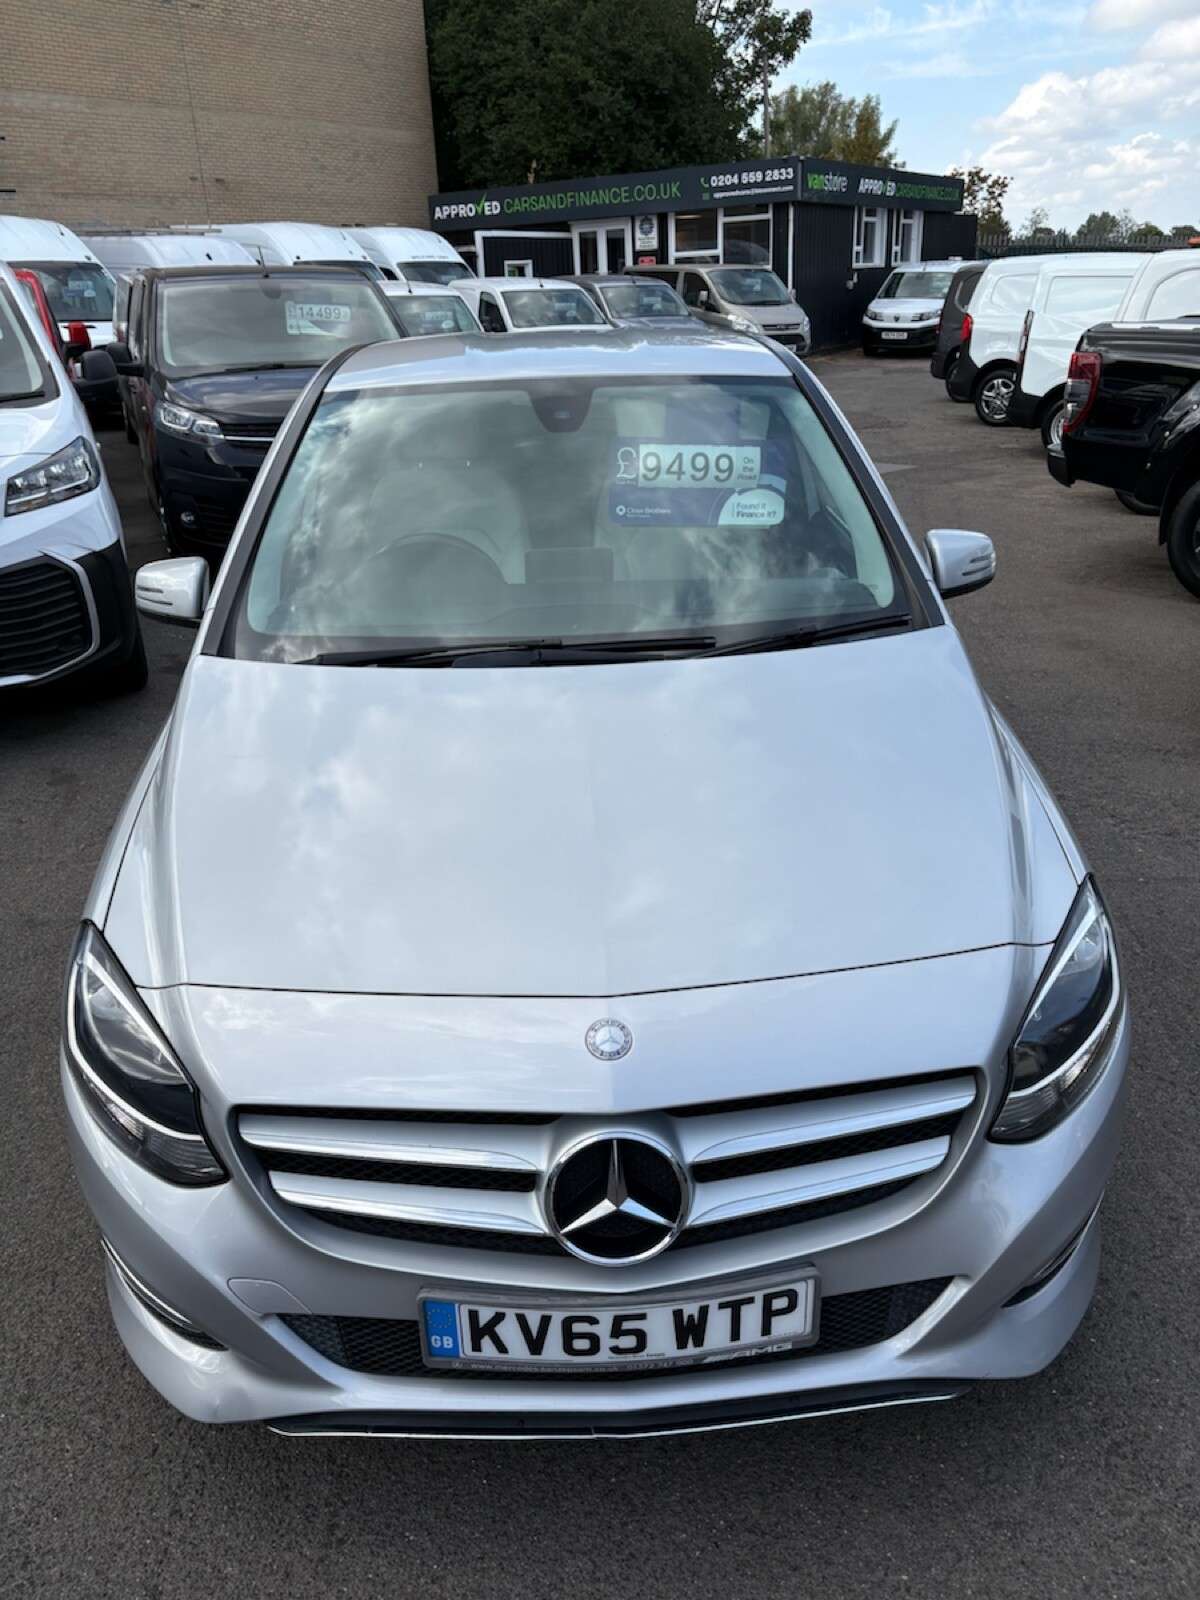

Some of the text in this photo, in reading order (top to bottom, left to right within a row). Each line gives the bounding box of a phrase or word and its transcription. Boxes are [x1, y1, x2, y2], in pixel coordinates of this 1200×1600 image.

[711, 173, 739, 187] 0204
[765, 167, 794, 182] 2833
[807, 171, 848, 193] vanstore
[434, 192, 500, 219] APPROVED
[504, 181, 681, 214] CARSANDFINANCE.CO.UK
[431, 1287, 799, 1356] GB KV65 WTP
